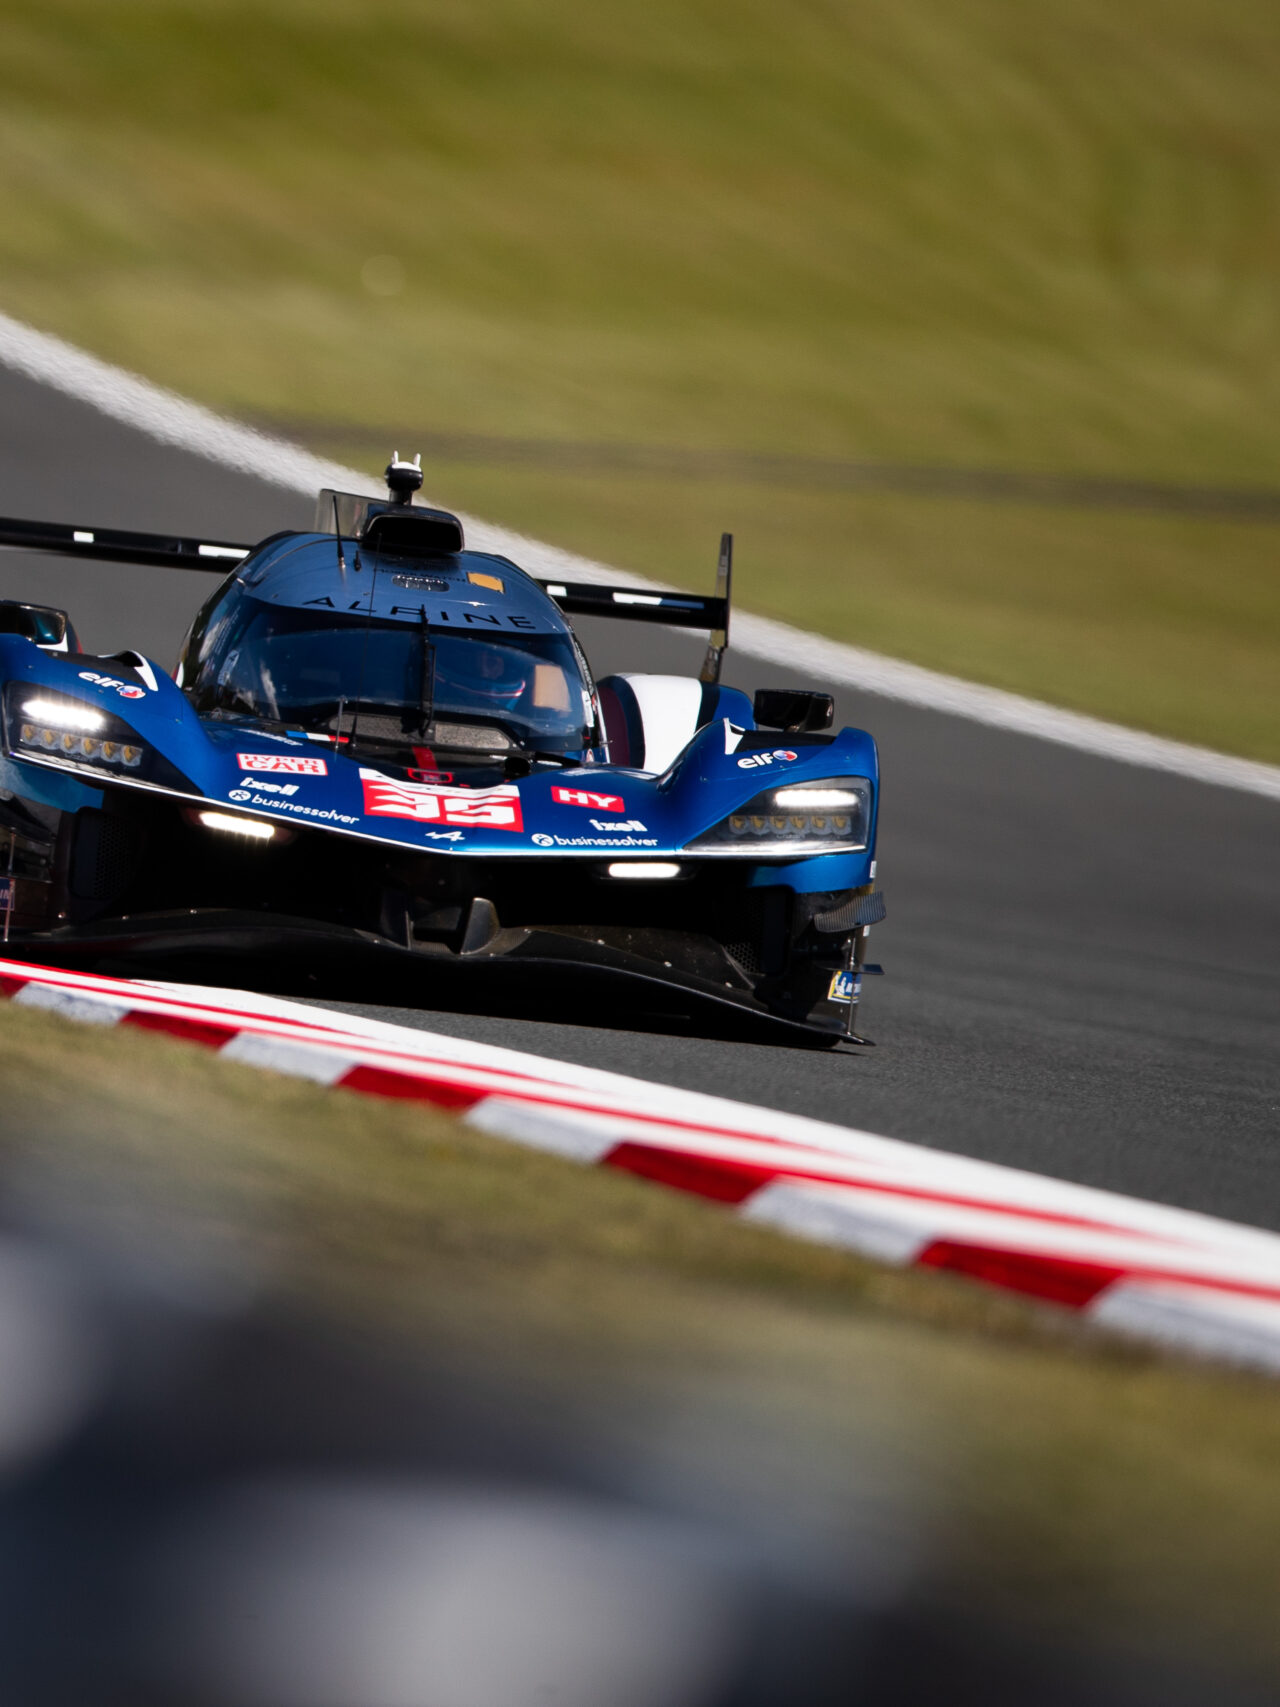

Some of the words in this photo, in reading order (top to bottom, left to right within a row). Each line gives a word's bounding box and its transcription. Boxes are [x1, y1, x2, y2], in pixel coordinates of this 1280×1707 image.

[302, 596, 536, 630] ALPINE
[78, 672, 124, 687] elf
[243, 755, 318, 765] HYPER
[246, 760, 320, 773] CAR
[737, 752, 774, 769] elf
[368, 785, 516, 825] 35
[558, 789, 618, 808] HY
[251, 794, 360, 825] businessolver
[553, 834, 658, 846] businessolver
